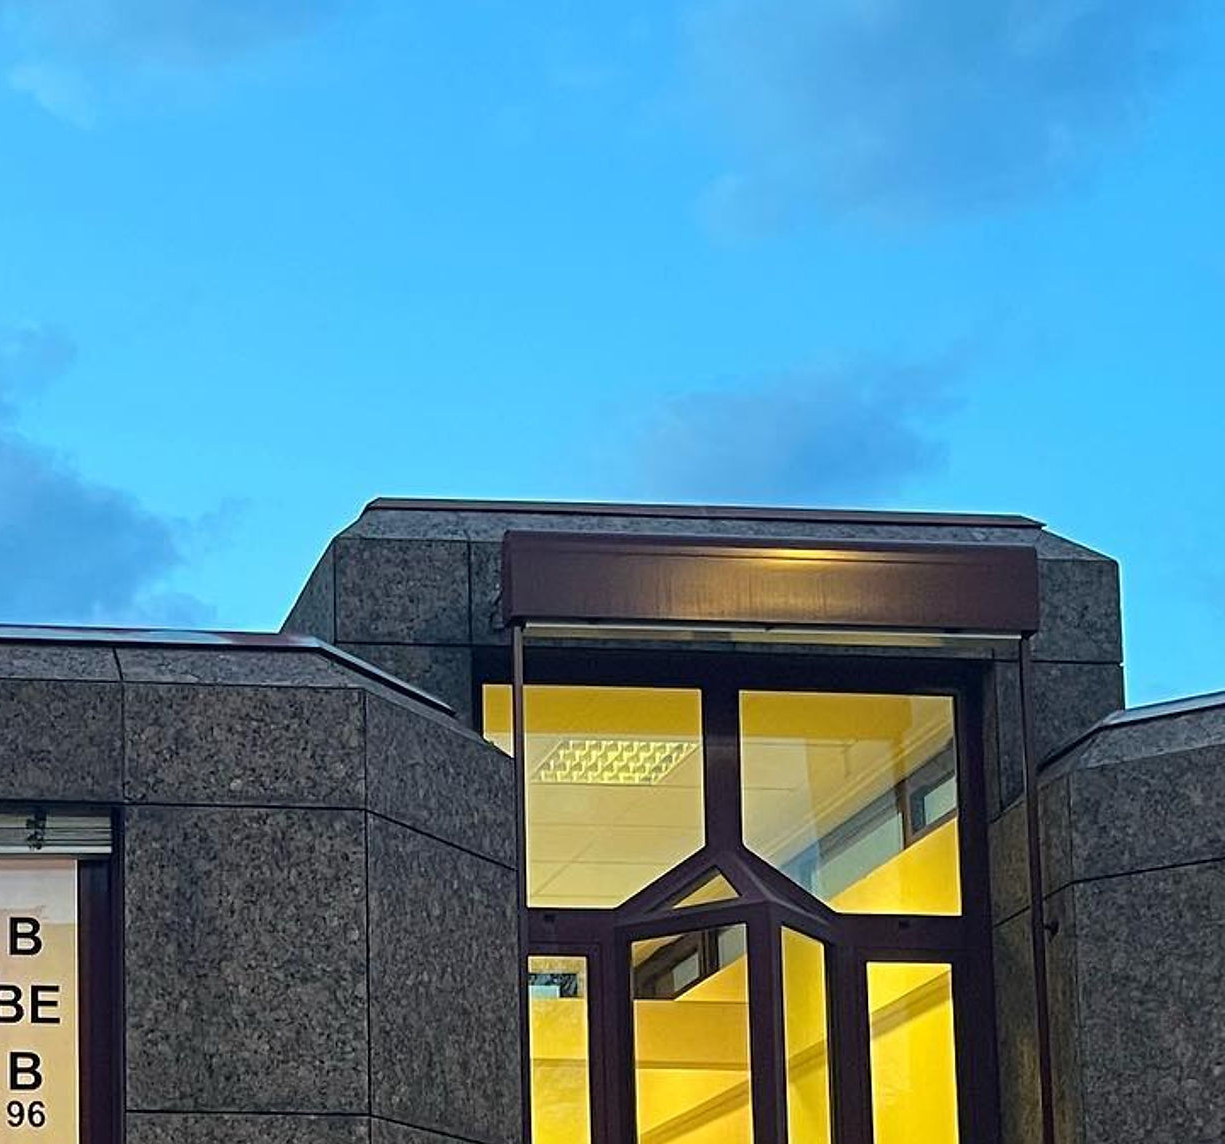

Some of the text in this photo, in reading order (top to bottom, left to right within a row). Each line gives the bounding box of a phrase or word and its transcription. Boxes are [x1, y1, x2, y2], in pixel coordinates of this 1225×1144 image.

[10, 917, 41, 955] B
[11, 1052, 41, 1089] B
[7, 1101, 45, 1127] 96
